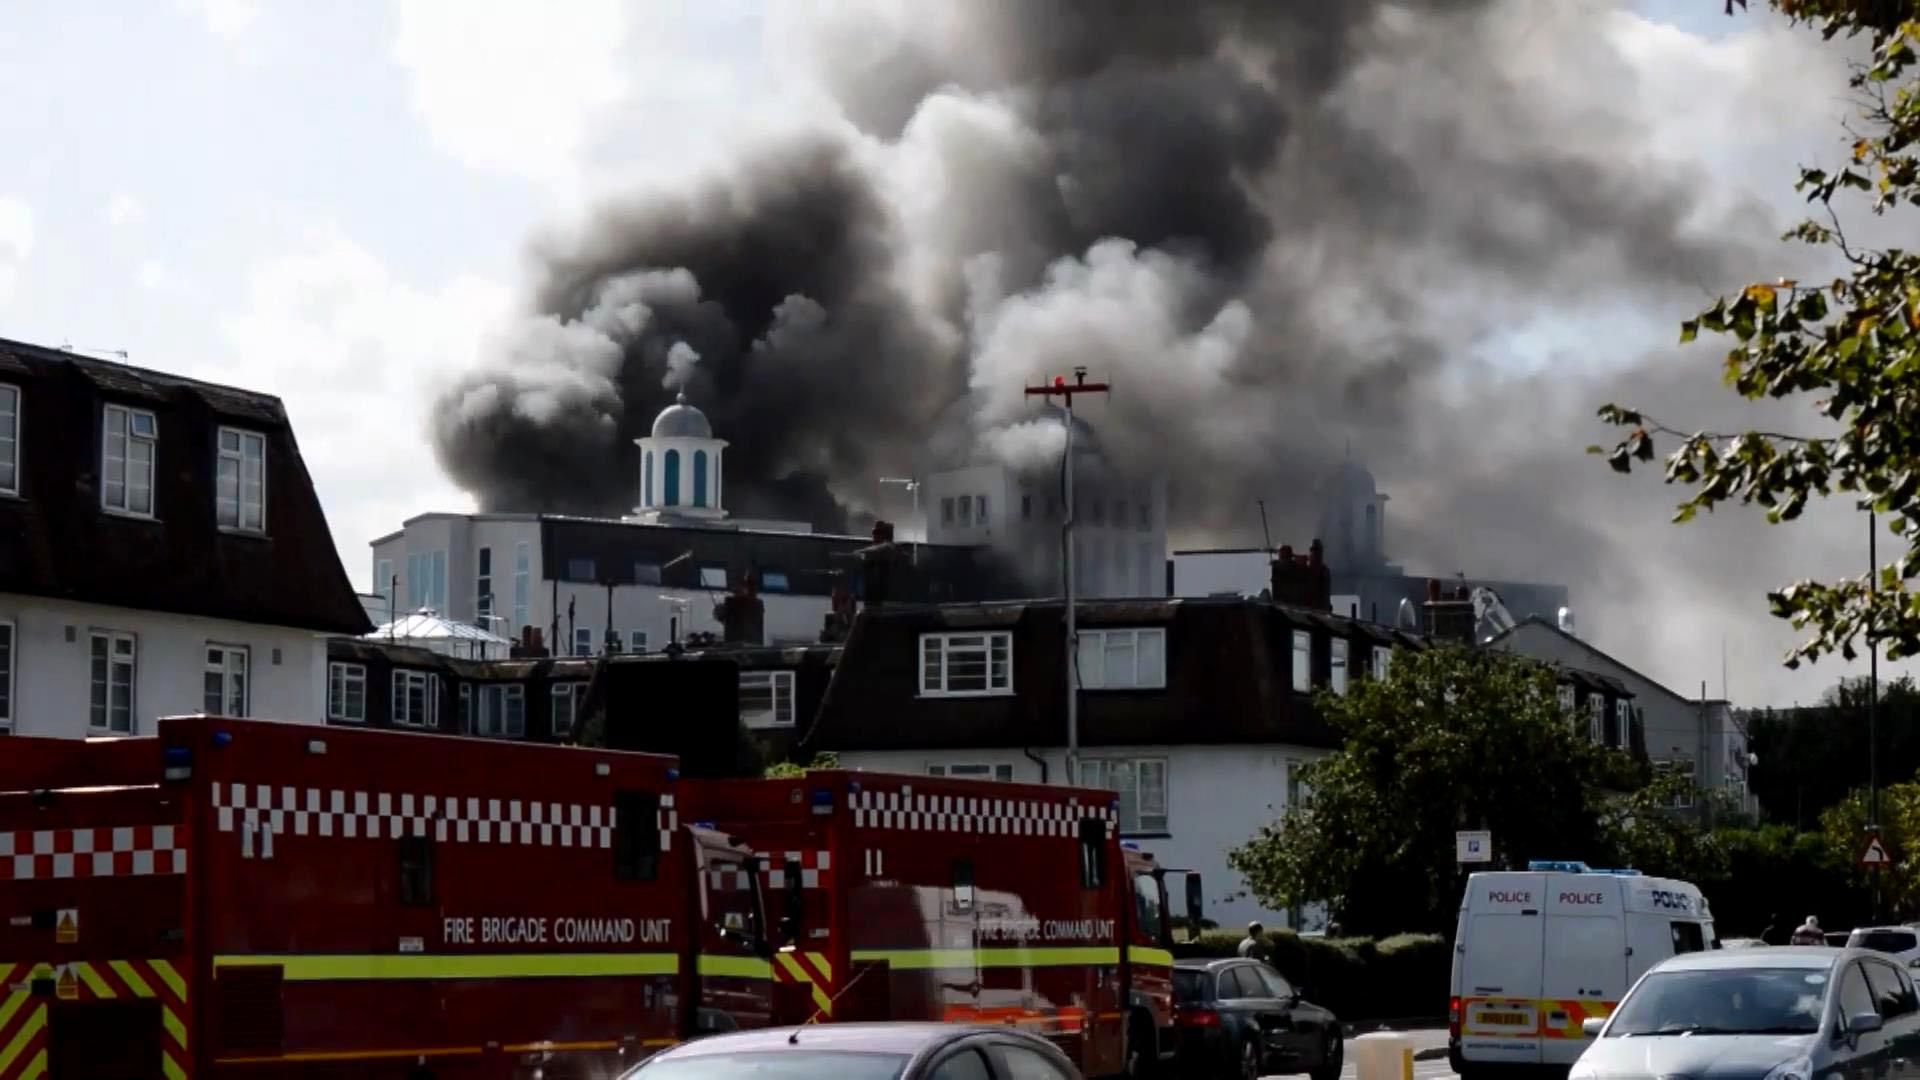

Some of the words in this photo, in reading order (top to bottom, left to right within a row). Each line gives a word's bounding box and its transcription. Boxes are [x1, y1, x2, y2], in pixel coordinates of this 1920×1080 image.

[1489, 891, 1530, 903] POLICE
[1559, 892, 1603, 904] POLICE
[443, 917, 474, 943] FIRE
[481, 917, 548, 943] BRIGADE
[554, 917, 634, 943] COMMAND
[640, 918, 671, 943] UNIT
[1044, 919, 1092, 940] COMMAND
[1096, 919, 1115, 940] UNIT
